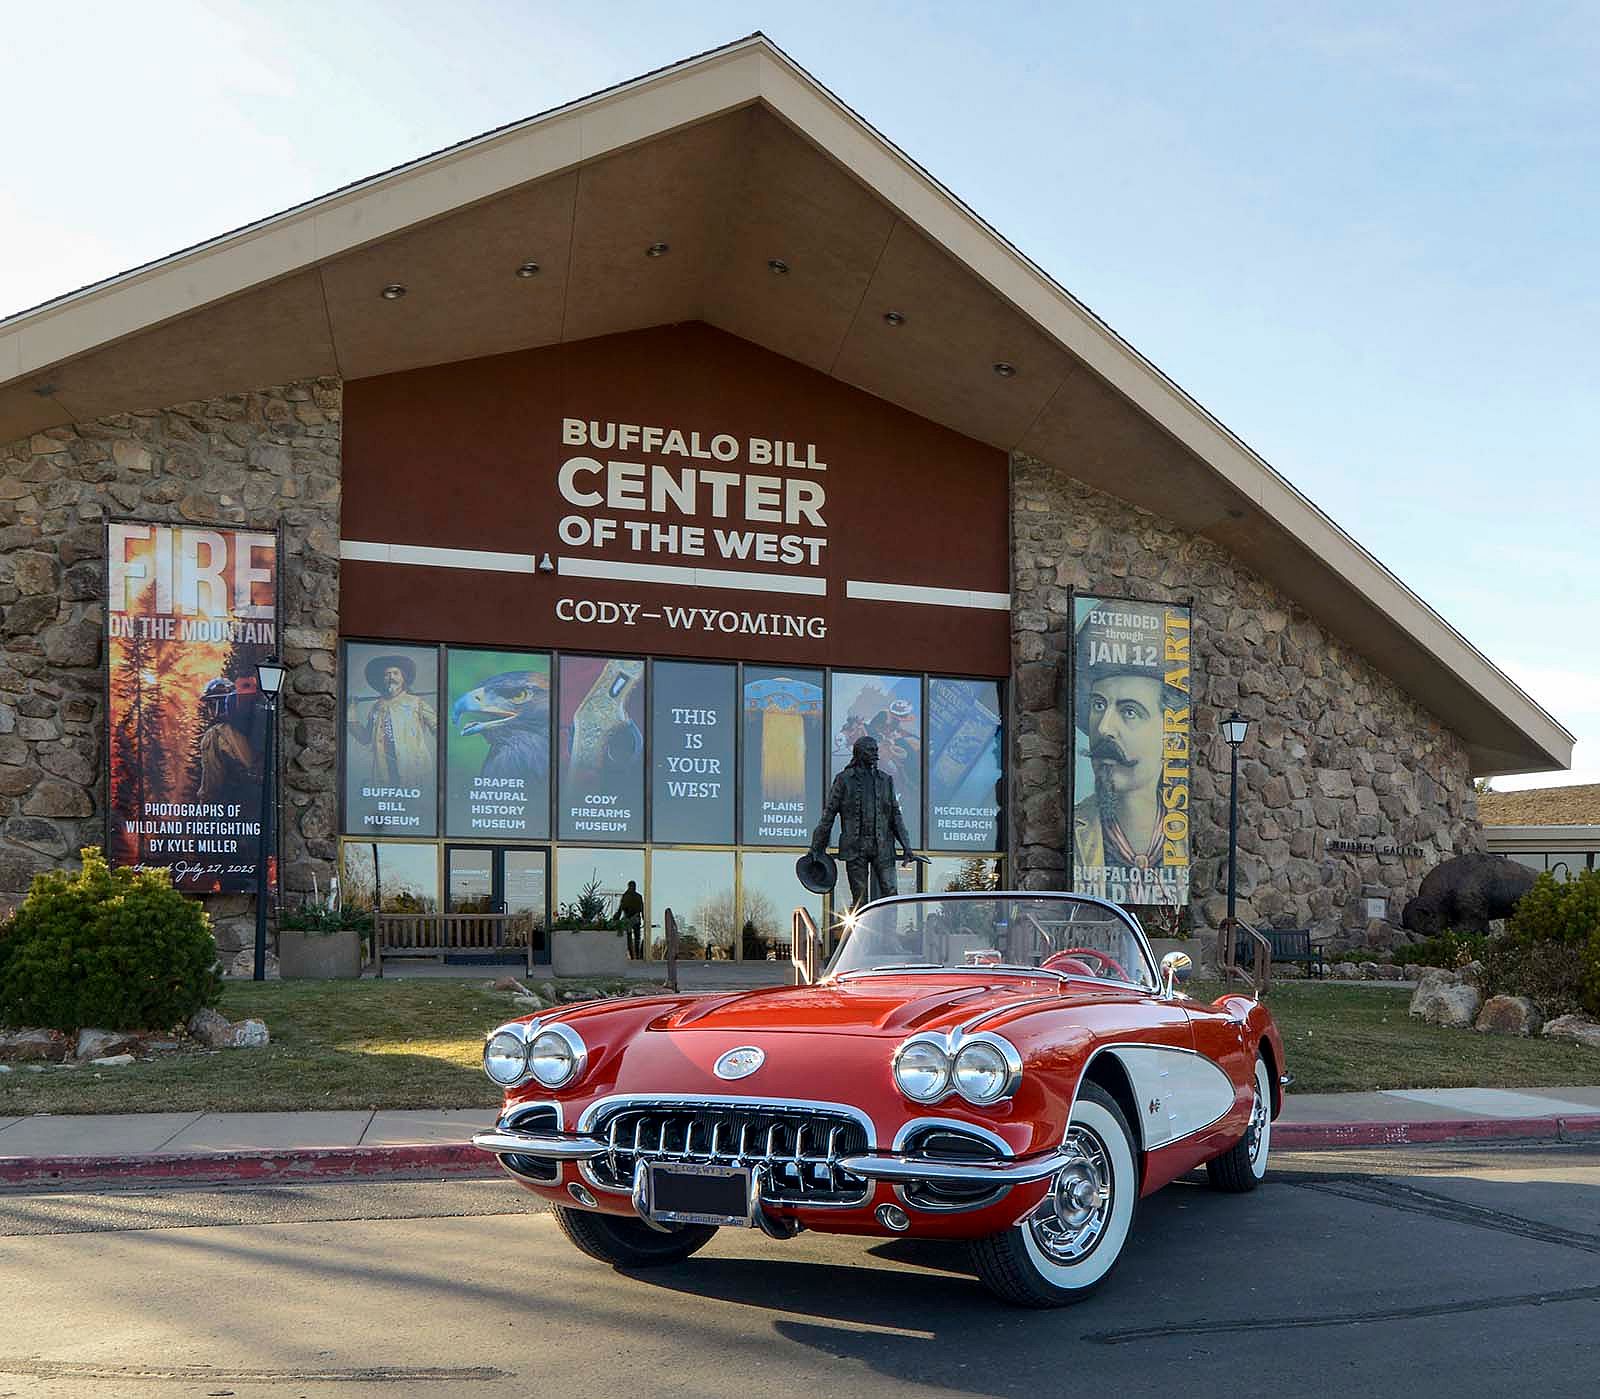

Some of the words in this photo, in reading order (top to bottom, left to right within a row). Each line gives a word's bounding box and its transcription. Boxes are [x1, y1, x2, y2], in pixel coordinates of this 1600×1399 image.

[562, 418, 740, 462] BUFFALO
[749, 438, 827, 471] BILL
[558, 456, 827, 528] CENTER
[558, 515, 617, 547] OF
[624, 521, 705, 556] THE
[713, 529, 827, 566] WEST
[109, 524, 276, 619] FIRE
[1090, 611, 1159, 630] EXTENDED
[109, 615, 135, 638] ON
[139, 617, 176, 640] THE
[181, 620, 276, 644] MOUNTAIN
[1105, 629, 1144, 643] through
[1089, 641, 1127, 666] JAN
[1132, 645, 1158, 667] 12
[1164, 608, 1190, 694] ART
[672, 709, 717, 725] THIS
[685, 734, 703, 749] IS
[667, 757, 721, 774] YOUR
[474, 777, 525, 789] DRAPER
[667, 782, 721, 798] WEST
[1163, 707, 1190, 866] POSTER
[362, 787, 421, 799] BUFFALO
[470, 791, 528, 802] NATURAL
[585, 795, 617, 805] CODY
[144, 803, 225, 817] PHOTOGRAPHS
[227, 805, 241, 818] OF
[378, 801, 406, 812] BILL
[471, 805, 525, 816] HISTORY
[571, 807, 631, 819] FIREARMS
[762, 802, 804, 812] PLAINS
[364, 815, 420, 827] MUSEUM
[472, 818, 526, 830] MUSEUM
[763, 814, 803, 824] INDIAN
[938, 819, 993, 829] RESEARCH
[125, 821, 182, 835] WILDLAND
[186, 822, 261, 836] FIREFIGHTING
[575, 821, 627, 832] MUSEUM
[759, 827, 808, 837] MUSEUM
[943, 832, 988, 842] LIBRARY
[150, 839, 164, 852] BY
[168, 839, 195, 853] KYLE
[198, 840, 237, 853] MILLER
[175, 860, 206, 883] July
[207, 864, 224, 875] 27,
[227, 864, 257, 874] 2025
[1074, 866, 1140, 882] BUFFALO
